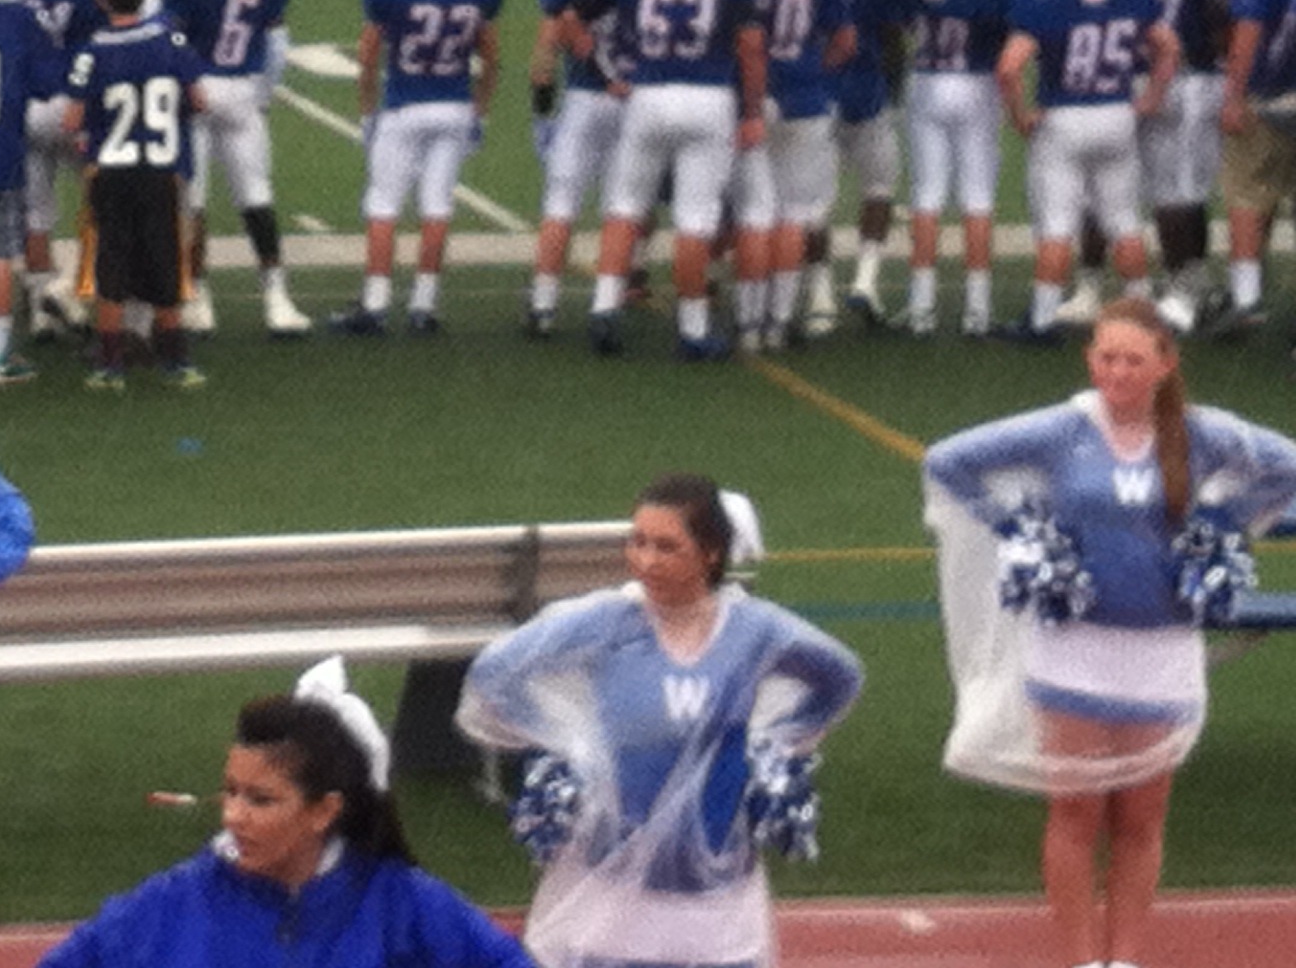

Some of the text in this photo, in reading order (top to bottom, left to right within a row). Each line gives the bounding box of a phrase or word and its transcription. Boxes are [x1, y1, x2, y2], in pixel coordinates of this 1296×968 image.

[398, 3, 480, 76] 22
[97, 76, 180, 166] 29
[1111, 467, 1156, 505] W
[663, 677, 709, 721] W
